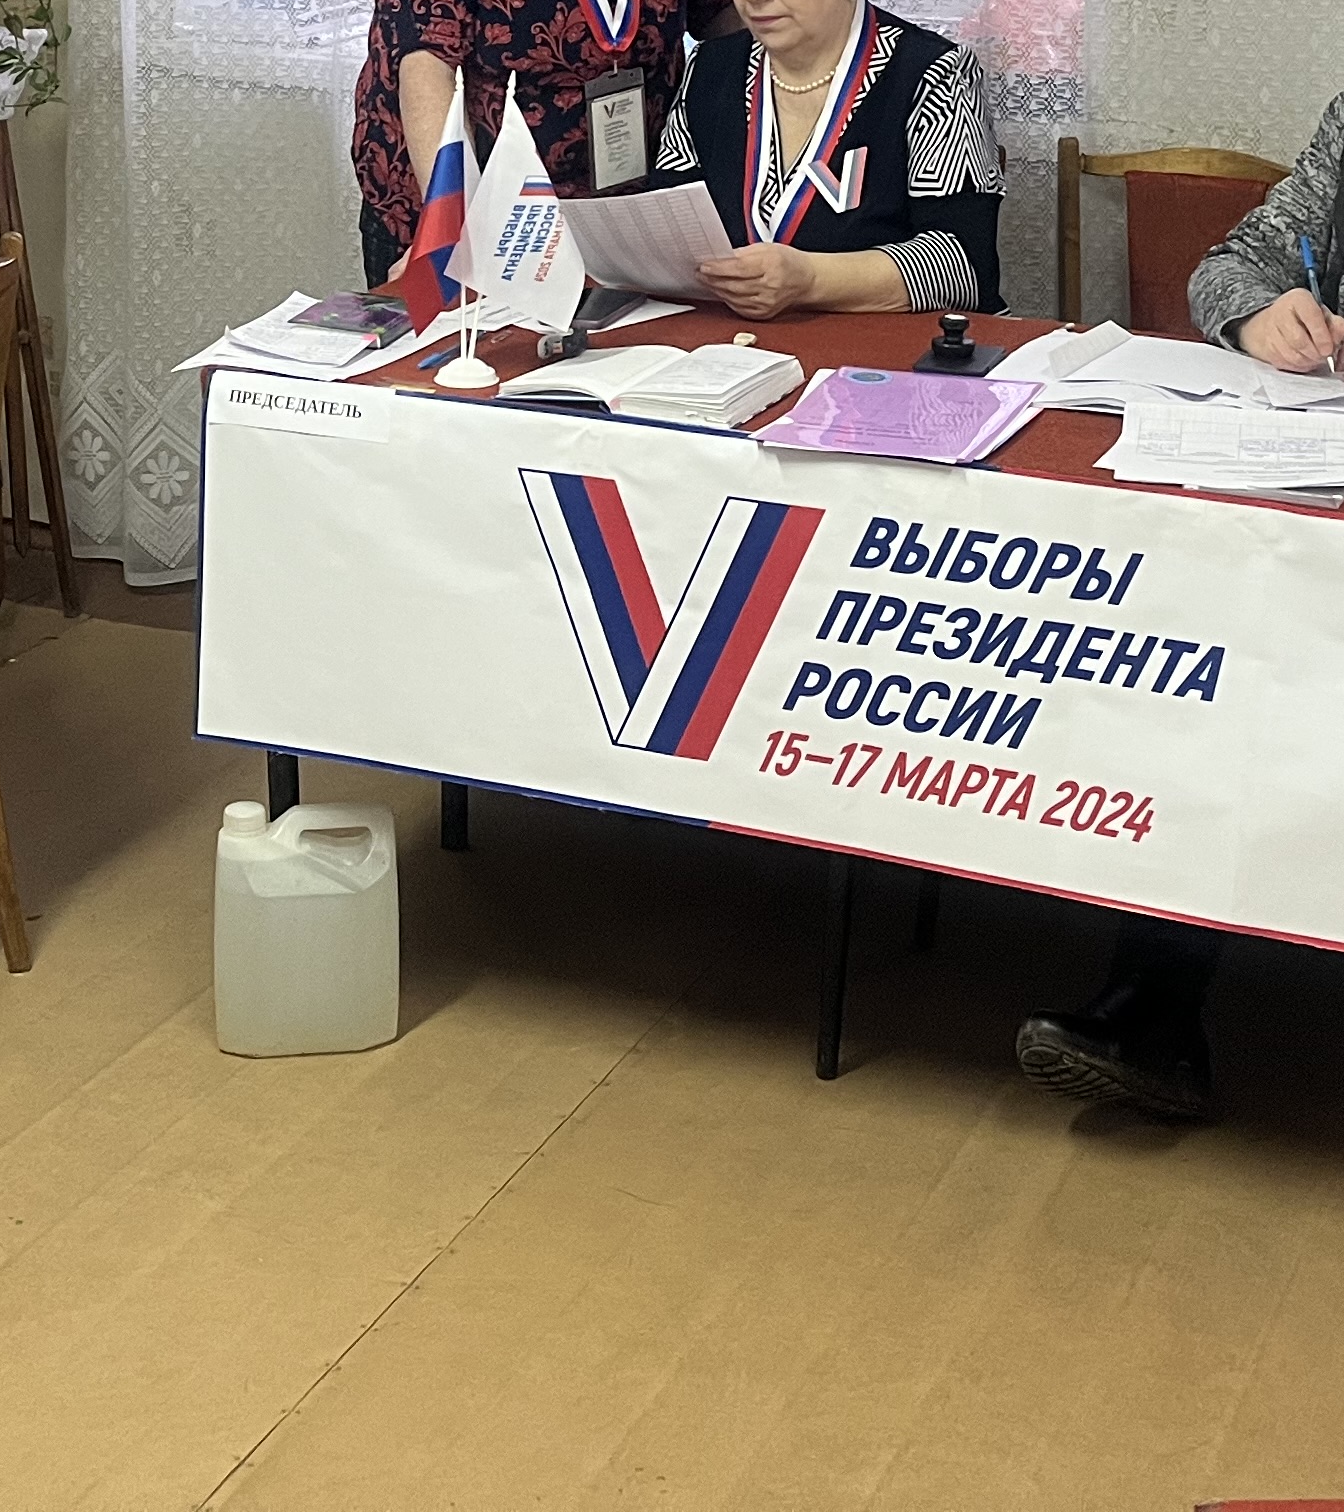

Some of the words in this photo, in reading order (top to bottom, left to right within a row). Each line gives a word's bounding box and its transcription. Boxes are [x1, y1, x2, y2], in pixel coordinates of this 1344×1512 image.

[228, 389, 362, 419] ПРЕДСЕДАТЕЛЬ
[850, 516, 1144, 606] ВЫБОРЫ
[815, 589, 1227, 702] ПРЕЗИДЕНТА
[782, 661, 1042, 750] РОССИИ
[880, 751, 1037, 821] МАРТА
[1039, 779, 1155, 843] 2024
